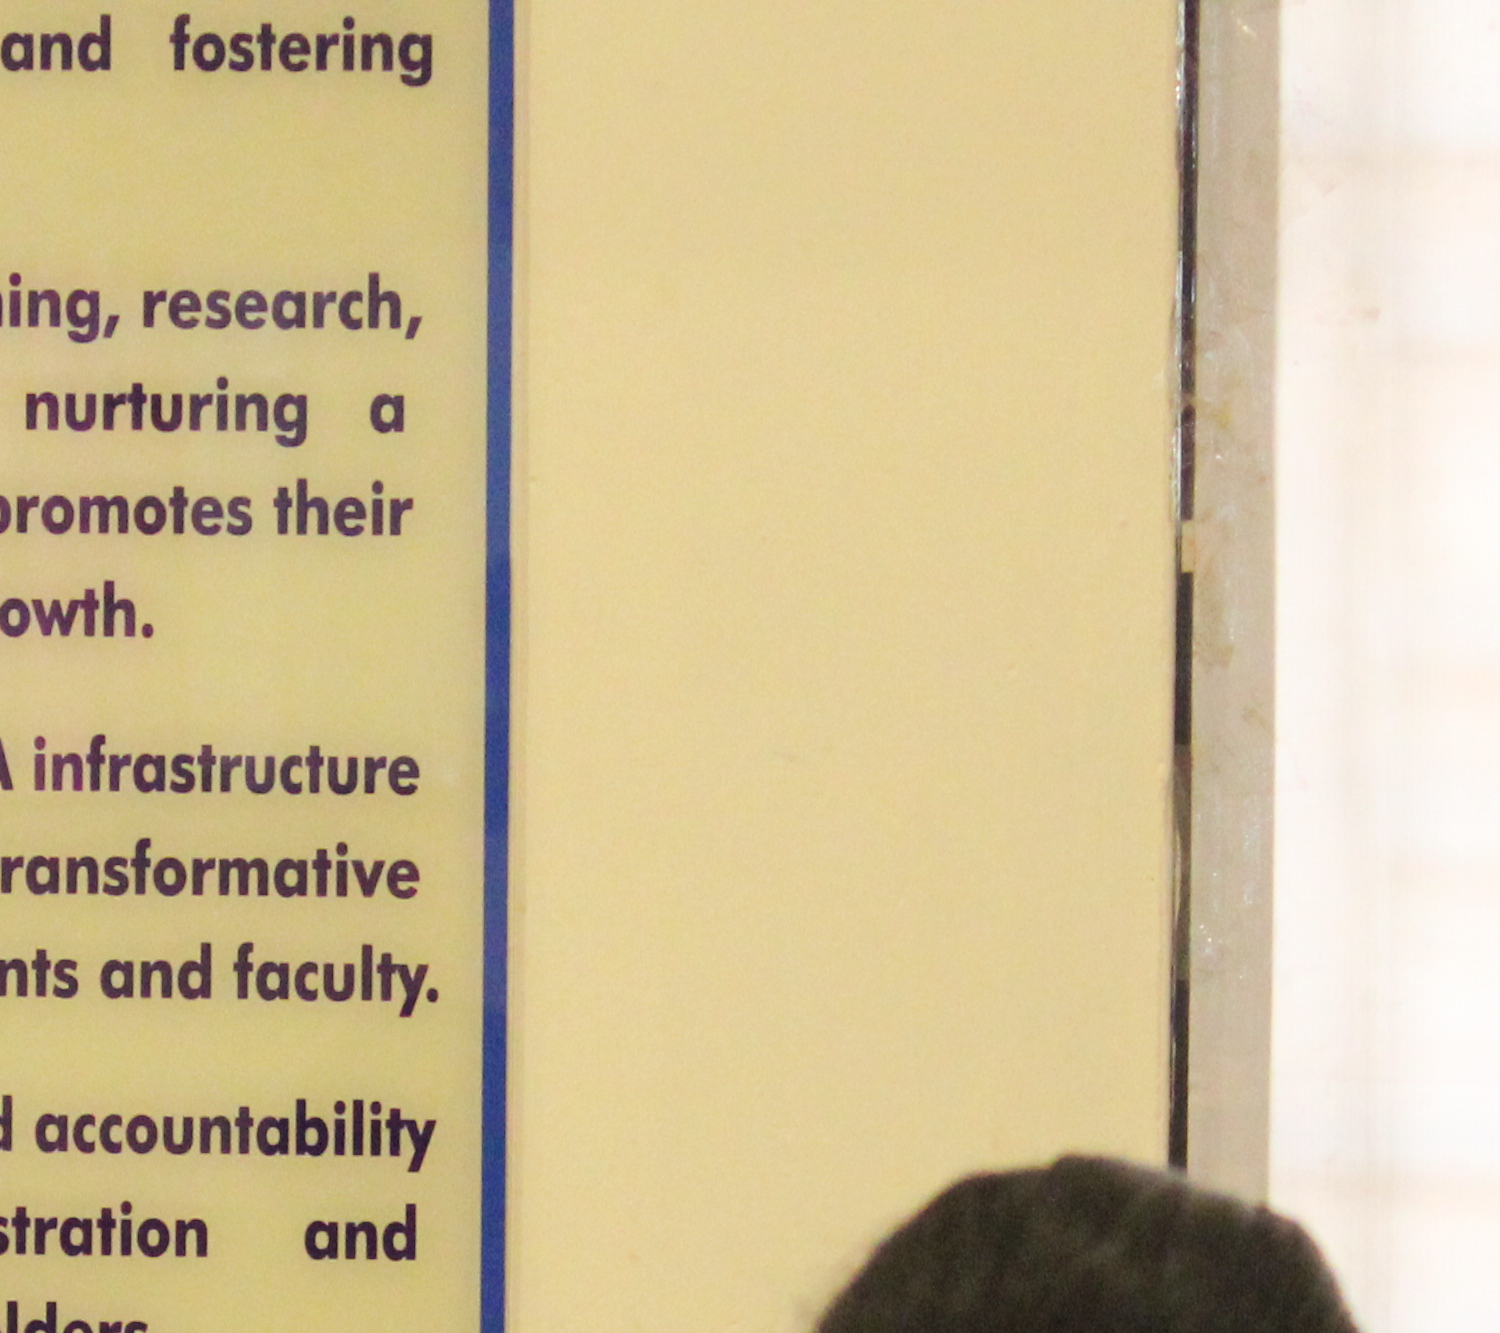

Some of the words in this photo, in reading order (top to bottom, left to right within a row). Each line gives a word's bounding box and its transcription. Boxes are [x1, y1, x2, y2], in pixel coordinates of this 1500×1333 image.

[0, 13, 113, 74] and
[168, 12, 434, 89] fostering
[142, 271, 423, 341] research,
[24, 375, 309, 449] nurturing
[369, 393, 406, 435] a
[272, 477, 415, 538] their
[33, 733, 421, 798] infrastructure
[99, 941, 213, 1002] and
[232, 940, 440, 1019] faculty.
[33, 1097, 438, 1174] accountability
[303, 1202, 418, 1263] and
